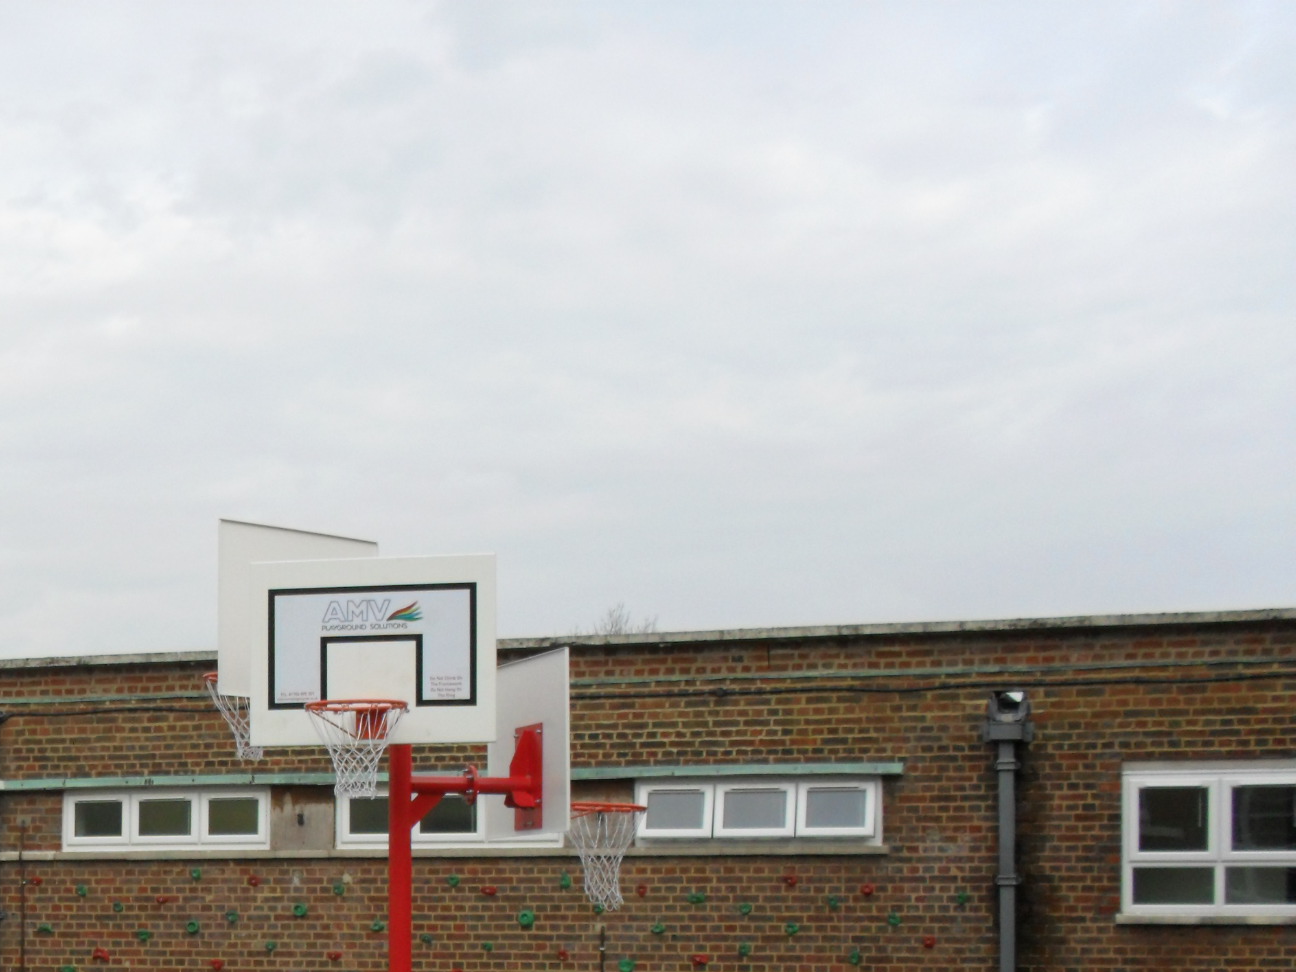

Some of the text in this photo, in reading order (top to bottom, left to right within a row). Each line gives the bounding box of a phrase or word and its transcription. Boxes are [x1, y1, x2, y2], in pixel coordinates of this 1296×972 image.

[322, 599, 391, 623] AMV
[321, 622, 408, 632] PLAYGROUND SOLUTIONS
